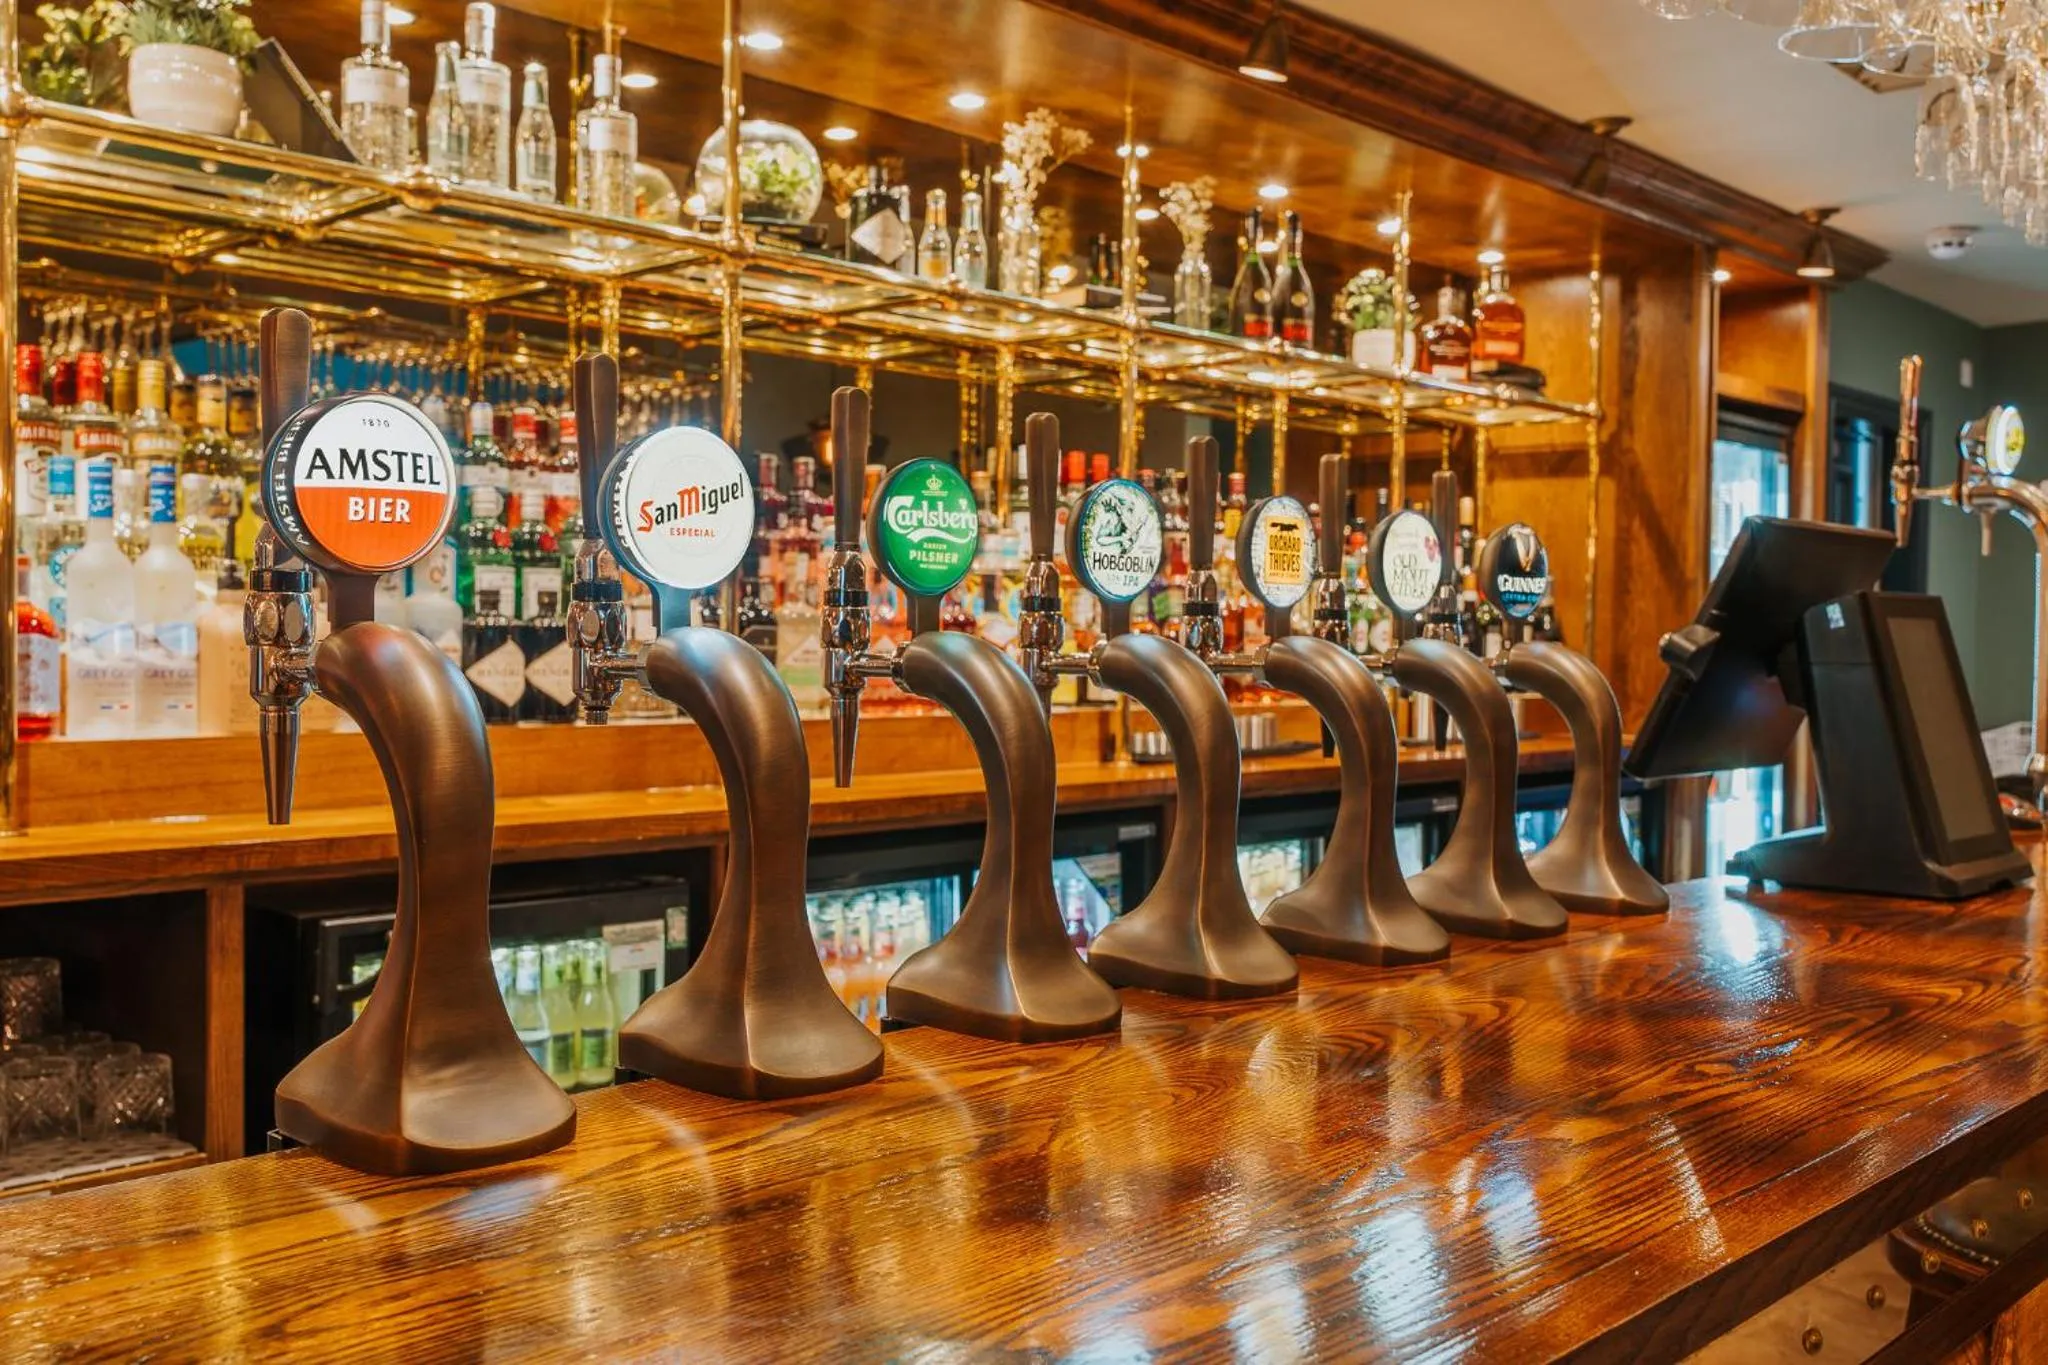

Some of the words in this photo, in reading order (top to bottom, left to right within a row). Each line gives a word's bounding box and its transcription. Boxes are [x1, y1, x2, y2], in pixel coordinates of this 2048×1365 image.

[362, 418, 391, 428] 1870
[305, 448, 441, 486] AMSTEL
[348, 496, 411, 523] BIER
[886, 495, 978, 538] Carlsberg
[669, 527, 716, 538] ESPECIAL
[1269, 534, 1301, 552] ORCHARD
[908, 550, 959, 564] PILSNER
[1093, 551, 1157, 574] HOBGOBLIN
[1269, 552, 1301, 572] THIEVES
